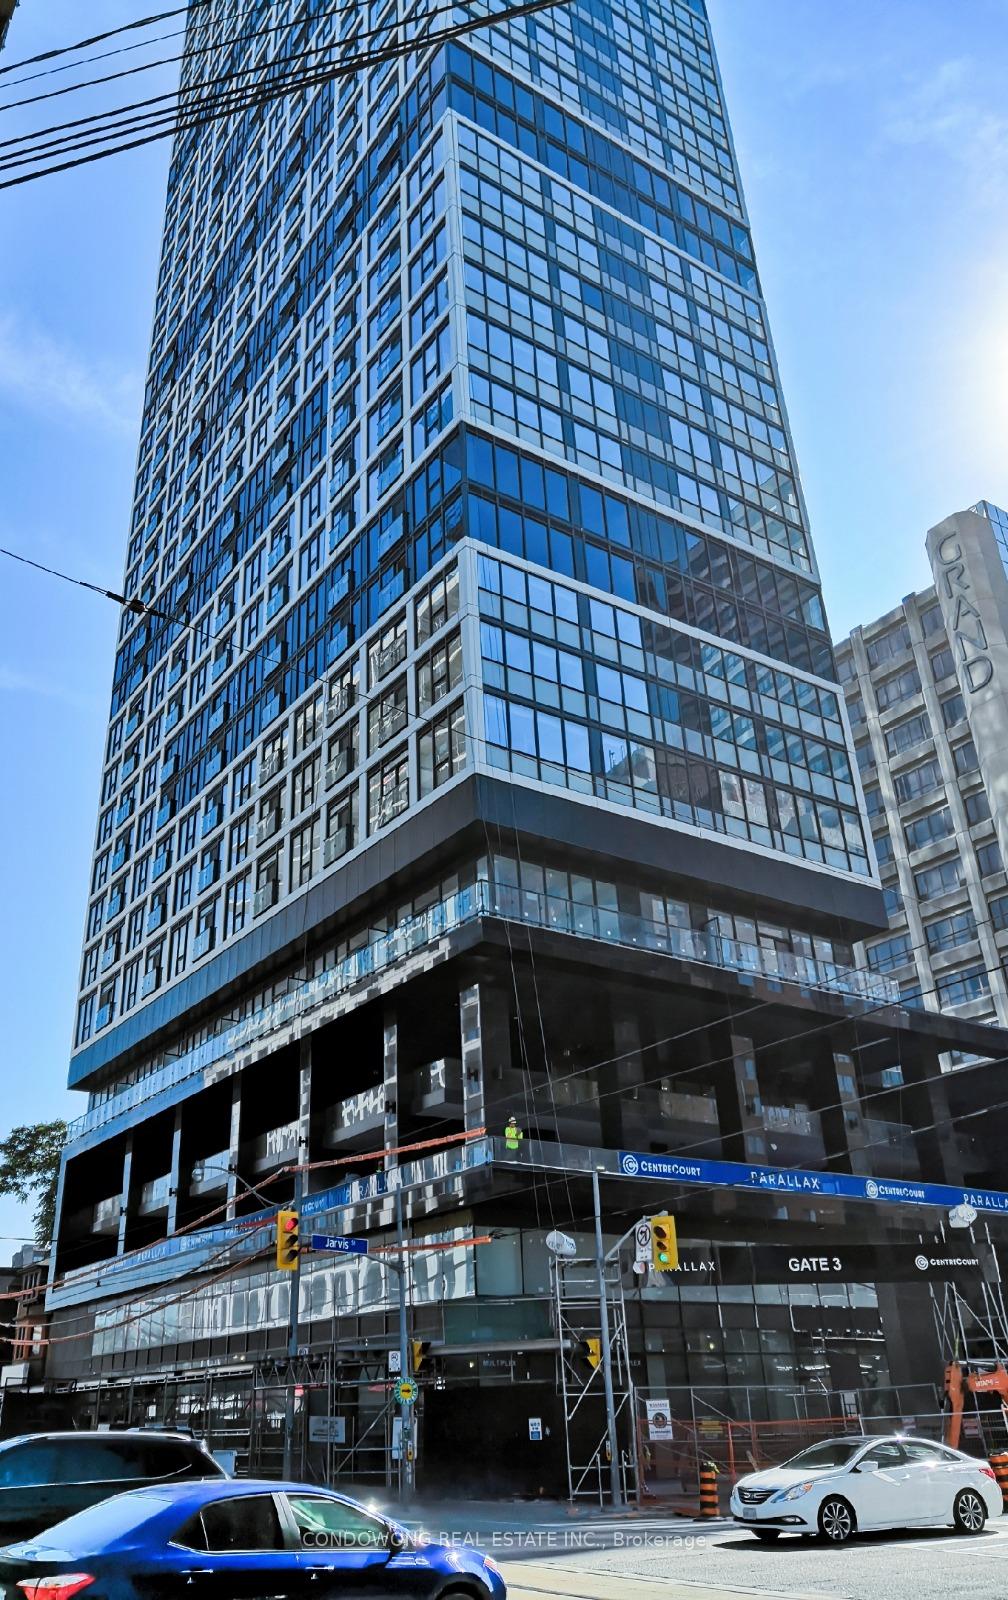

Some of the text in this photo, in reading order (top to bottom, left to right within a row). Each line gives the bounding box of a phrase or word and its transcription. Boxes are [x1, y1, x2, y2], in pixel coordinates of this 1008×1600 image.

[937, 531, 994, 694] GRAND
[750, 1171, 820, 1190] PARALLAX
[325, 1238, 349, 1250] Jarvis
[788, 1257, 842, 1271] GATE 3
